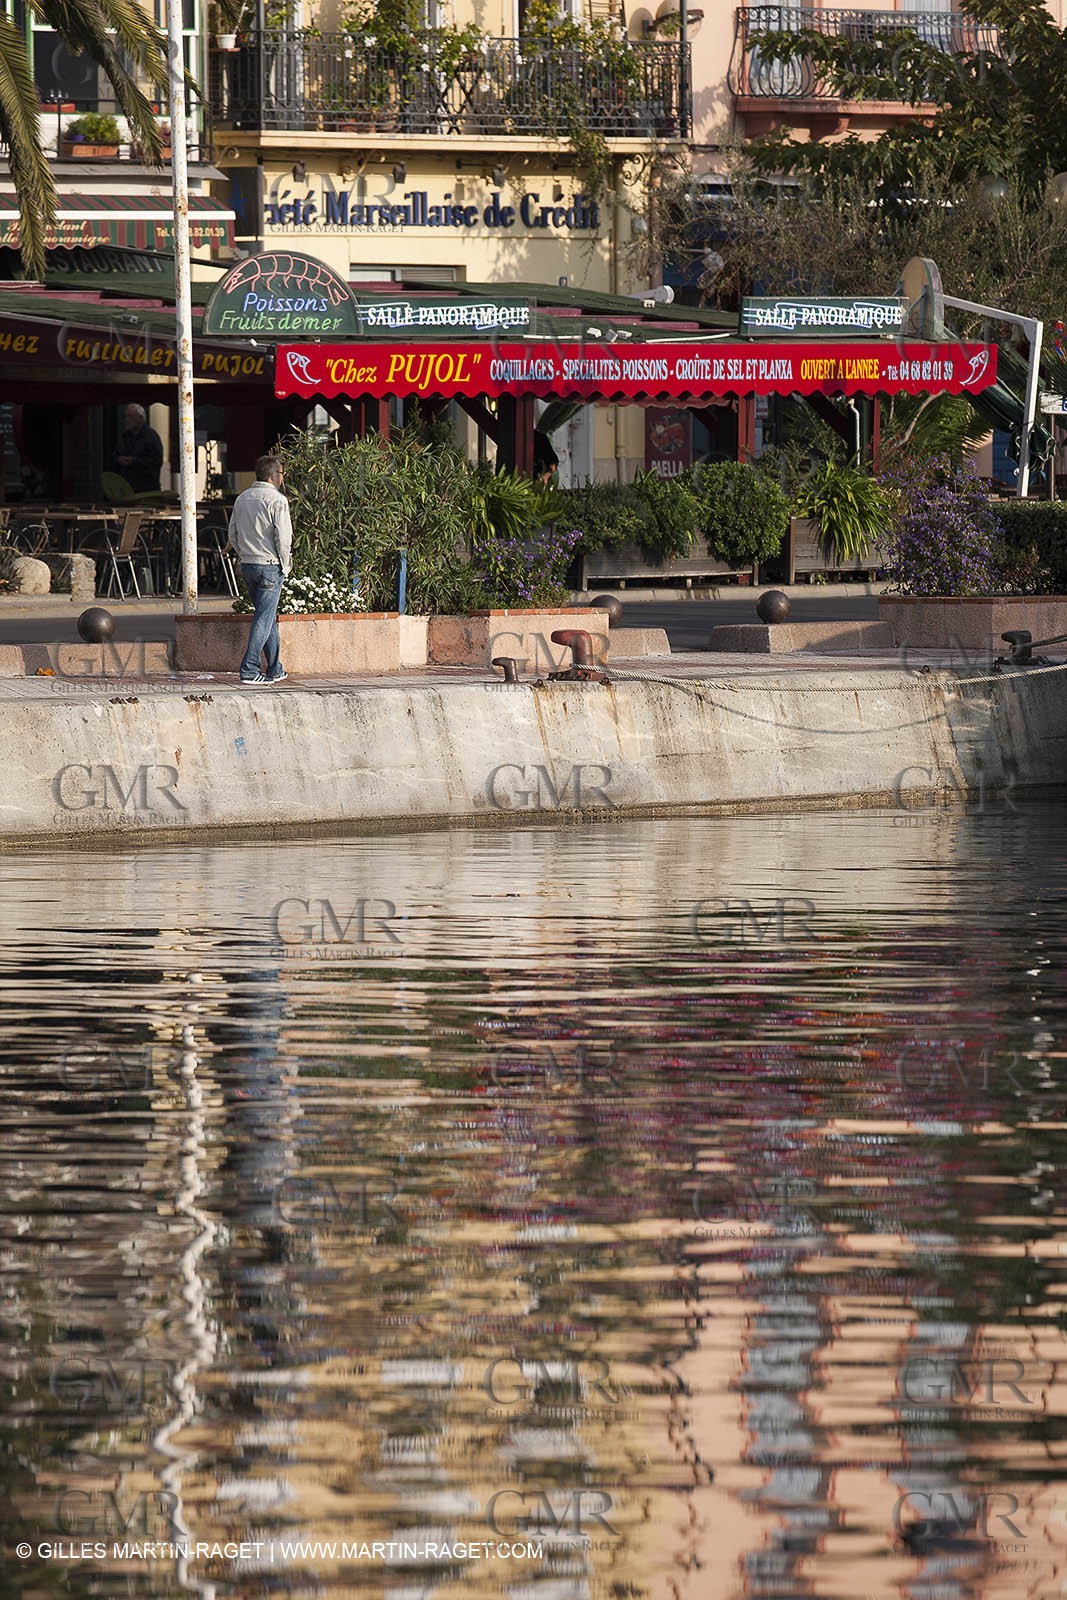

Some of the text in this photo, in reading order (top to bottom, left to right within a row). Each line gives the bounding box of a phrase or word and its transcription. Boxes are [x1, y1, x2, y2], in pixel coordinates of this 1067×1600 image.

[323, 190, 479, 228] Marseillaise
[483, 192, 516, 228] de
[519, 192, 600, 230] Crédit
[48, 252, 165, 272] STAURANT
[243, 292, 328, 312] Poissons
[368, 307, 530, 329] SALLE PANORAMIQUE
[755, 307, 902, 328] SALLE PANORAMIQUE
[201, 353, 265, 376] PUJOL
[326, 354, 377, 384] "Chez
[490, 359, 554, 383] COQUILLAGES
[562, 359, 620, 381] SPECIALITES
[622, 359, 668, 381] POISSONS
[676, 353, 711, 381] CROÛTE
[713, 359, 726, 381] DE
[727, 359, 744, 381] SEL
[746, 359, 758, 381] ET
[759, 359, 793, 381] PLANXA
[801, 359, 836, 380] OUVERT
[837, 359, 845, 380] A
[846, 359, 880, 380] L'ANNEE
[900, 360, 909, 380] 04
[911, 360, 921, 380] 68
[922, 360, 932, 380] 82
[933, 360, 942, 380] 01
[944, 360, 953, 380] 39
